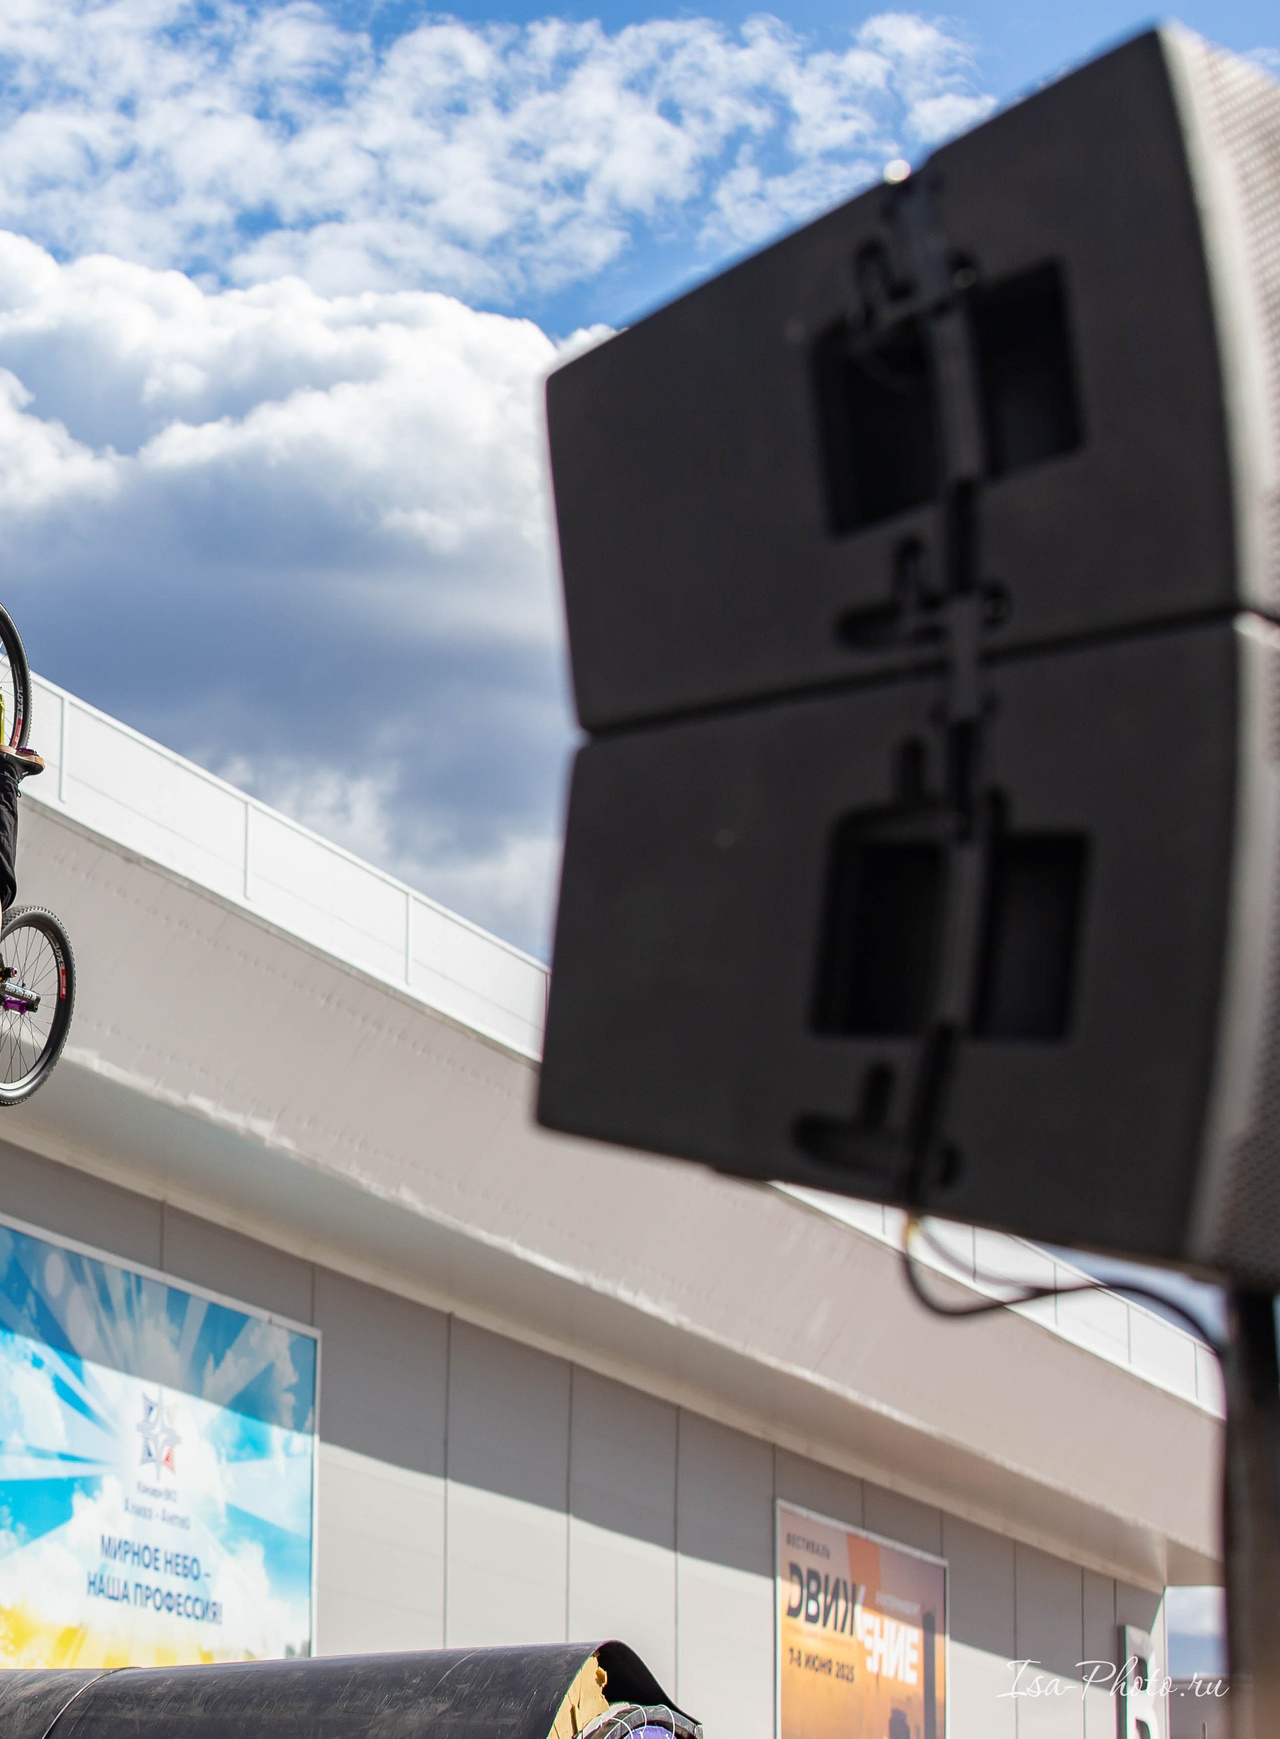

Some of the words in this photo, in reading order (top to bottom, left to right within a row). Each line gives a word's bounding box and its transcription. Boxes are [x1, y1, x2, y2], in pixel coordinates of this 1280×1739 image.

[101, 1533, 161, 1571] МИРНОЕ
[164, 1550, 201, 1581] НЕБО
[785, 1531, 831, 1559] ФЕСТИВАЛЬ
[86, 1570, 130, 1604] НАША
[134, 1581, 223, 1625] ПРОФЕССИЯ!
[789, 1646, 802, 1668] 7-8
[805, 1653, 833, 1676] ИЮНЯ
[835, 1661, 855, 1683] 2025
